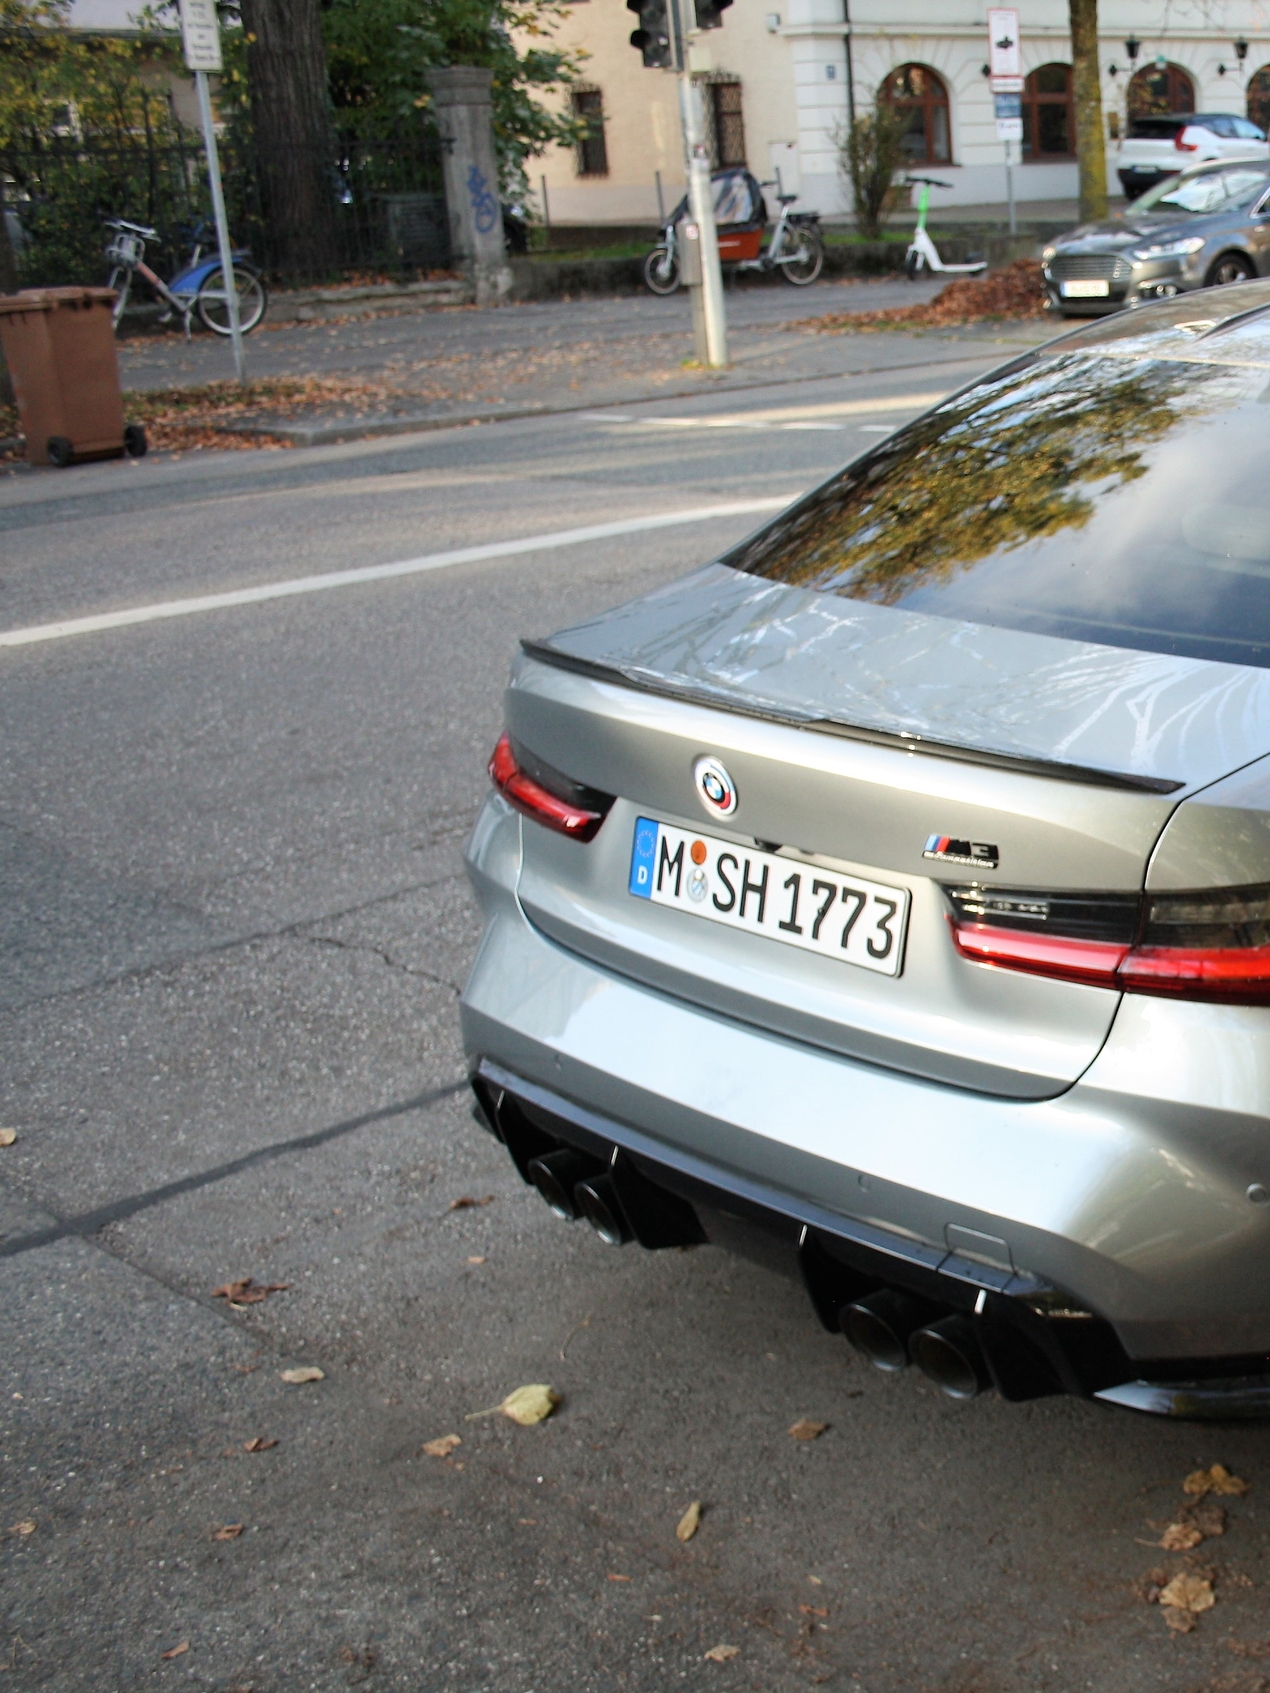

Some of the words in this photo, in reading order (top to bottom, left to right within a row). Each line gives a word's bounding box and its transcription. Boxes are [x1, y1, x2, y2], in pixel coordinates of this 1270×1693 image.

[638, 866, 648, 885] D
[657, 836, 684, 897] M
[945, 838, 999, 860] M3
